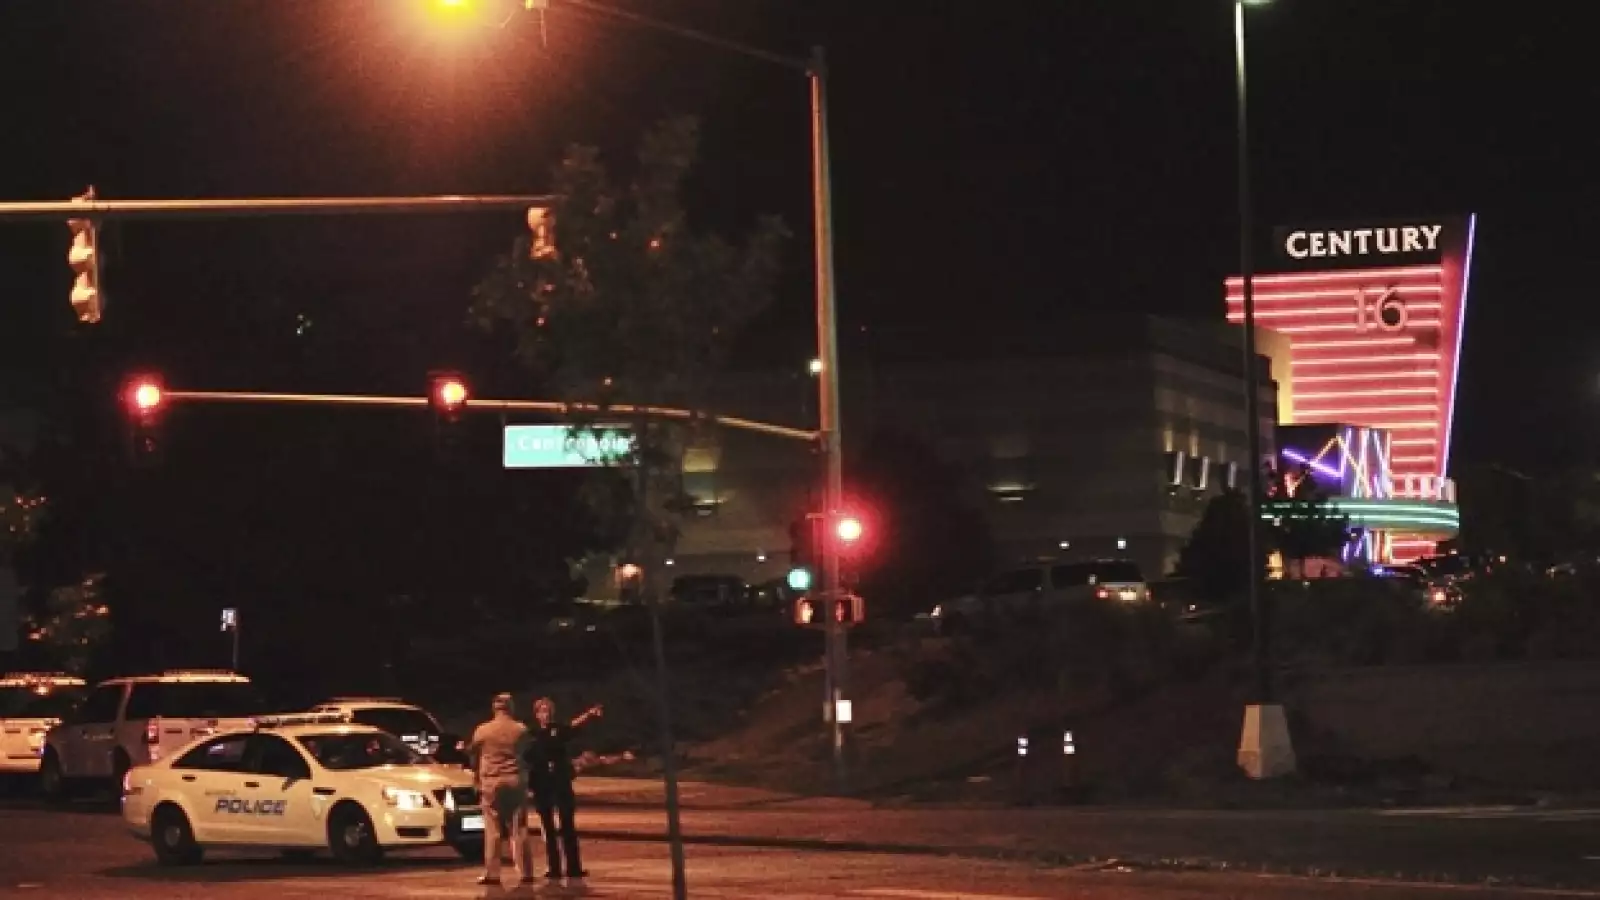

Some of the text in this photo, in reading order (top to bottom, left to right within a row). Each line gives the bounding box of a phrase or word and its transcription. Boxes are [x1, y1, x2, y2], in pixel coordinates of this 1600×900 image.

[1285, 225, 1442, 258] CENTURY
[1354, 285, 1408, 333] 16
[213, 799, 287, 817] POLICE
